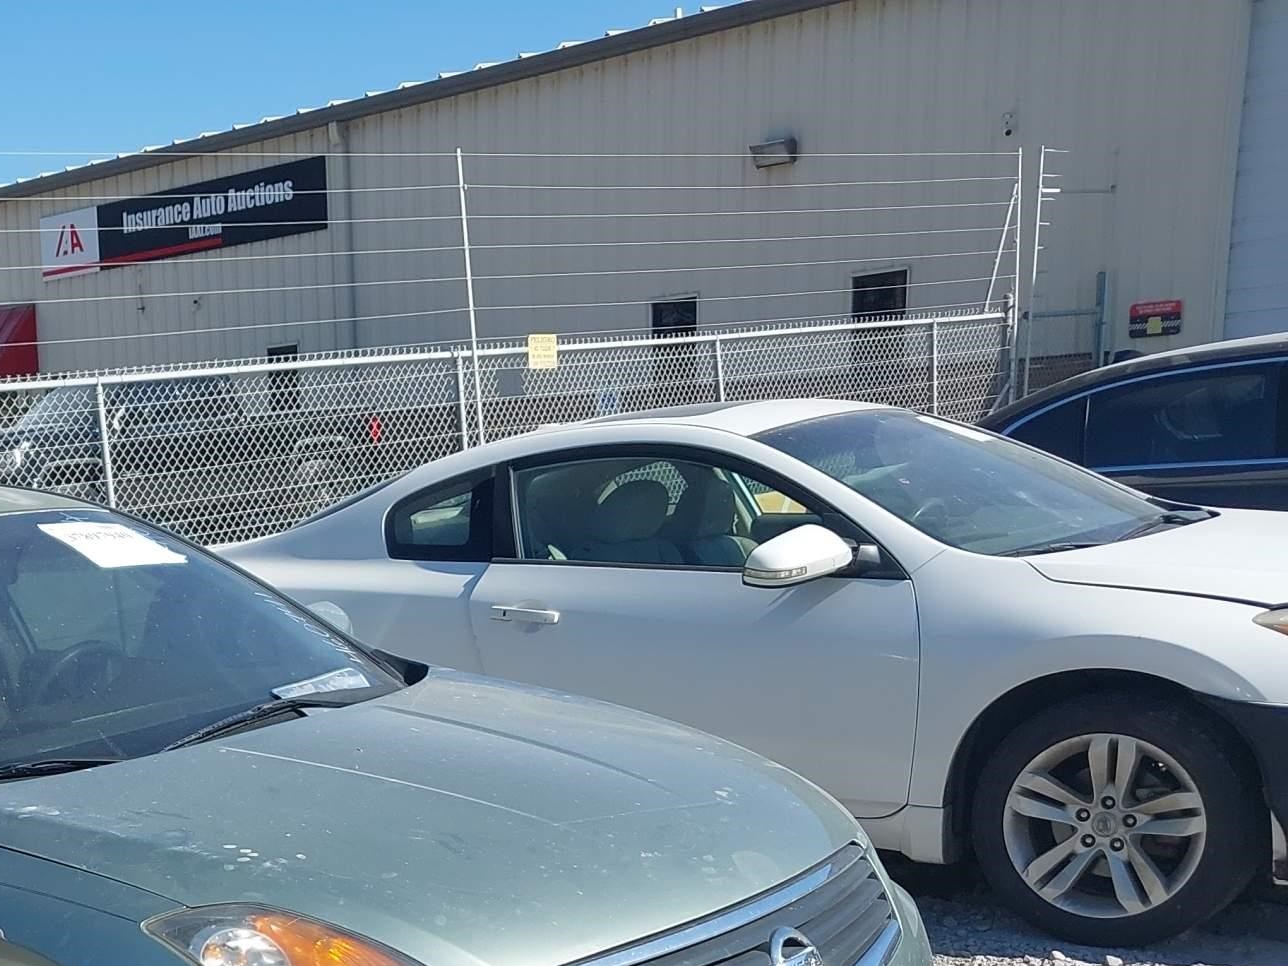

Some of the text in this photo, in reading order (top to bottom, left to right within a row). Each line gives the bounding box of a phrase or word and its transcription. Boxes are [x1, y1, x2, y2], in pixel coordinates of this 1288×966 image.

[122, 180, 294, 234] Insurance Auto Auctions
